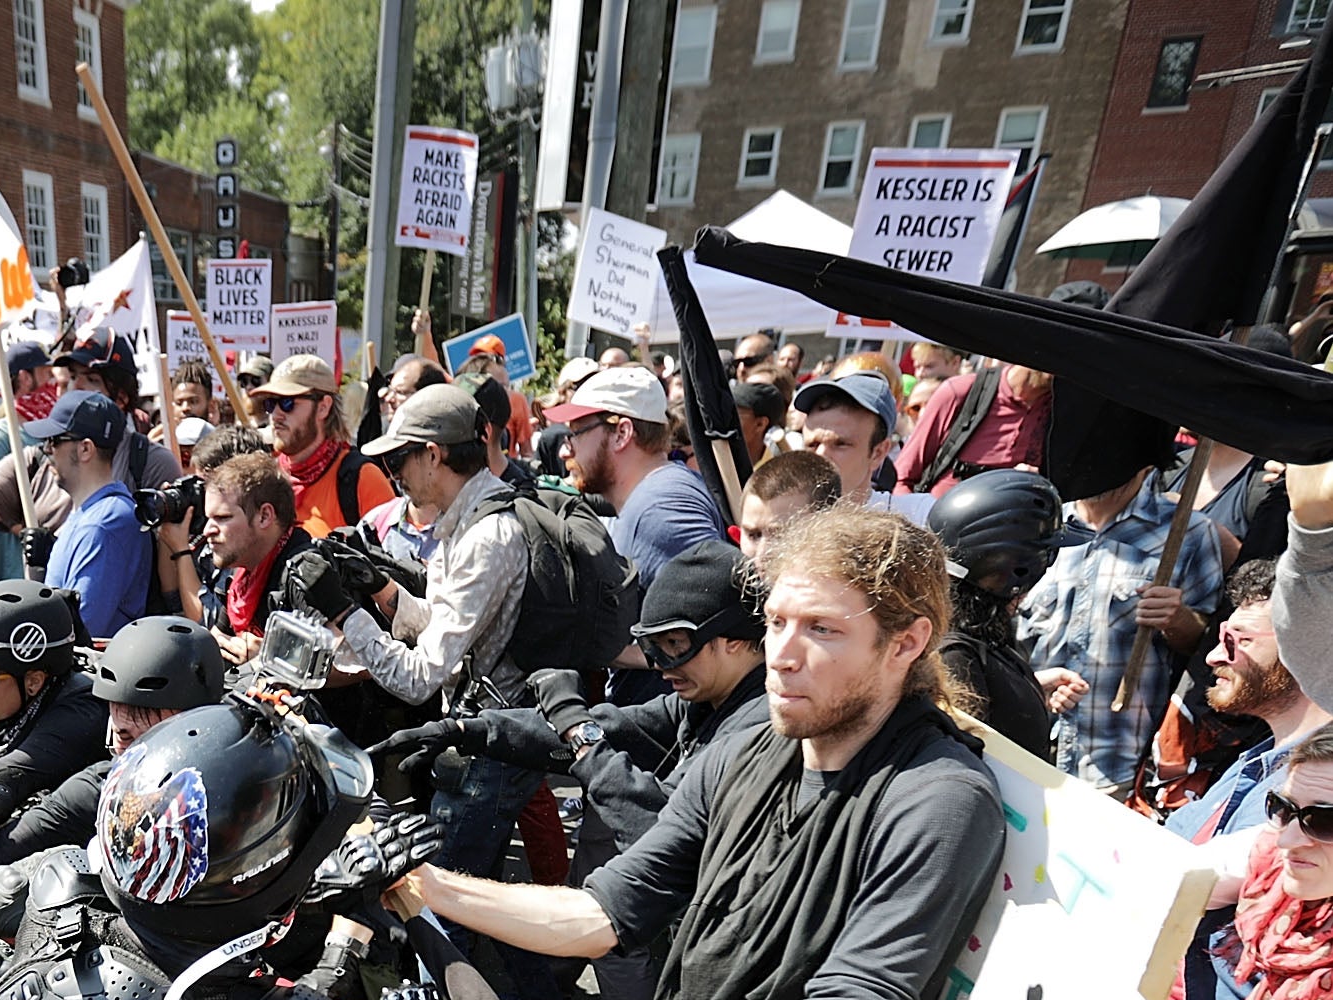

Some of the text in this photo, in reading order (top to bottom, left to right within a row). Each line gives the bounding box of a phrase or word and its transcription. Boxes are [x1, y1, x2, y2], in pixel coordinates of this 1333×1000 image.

[424, 148, 460, 169] MAKE
[413, 166, 465, 191] RACISTS
[876, 178, 995, 202] KESSLER IS
[414, 188, 462, 211] AFRAID
[416, 208, 457, 229] AGAIN
[875, 215, 975, 239] A RACIST
[470, 180, 492, 314] Downtown Mall
[600, 222, 655, 259] General
[595, 245, 650, 279] Sherman
[883, 249, 953, 273] SEWER
[215, 268, 263, 286] BLACK
[607, 270, 626, 286] Did
[219, 289, 259, 306] LIVES
[588, 278, 637, 315] Nothing
[213, 310, 266, 326] MATTER
[593, 301, 630, 333] Wrong
[175, 338, 206, 353] RACIS
[287, 331, 319, 342] IS NAZI
[223, 932, 264, 956] UNDER
